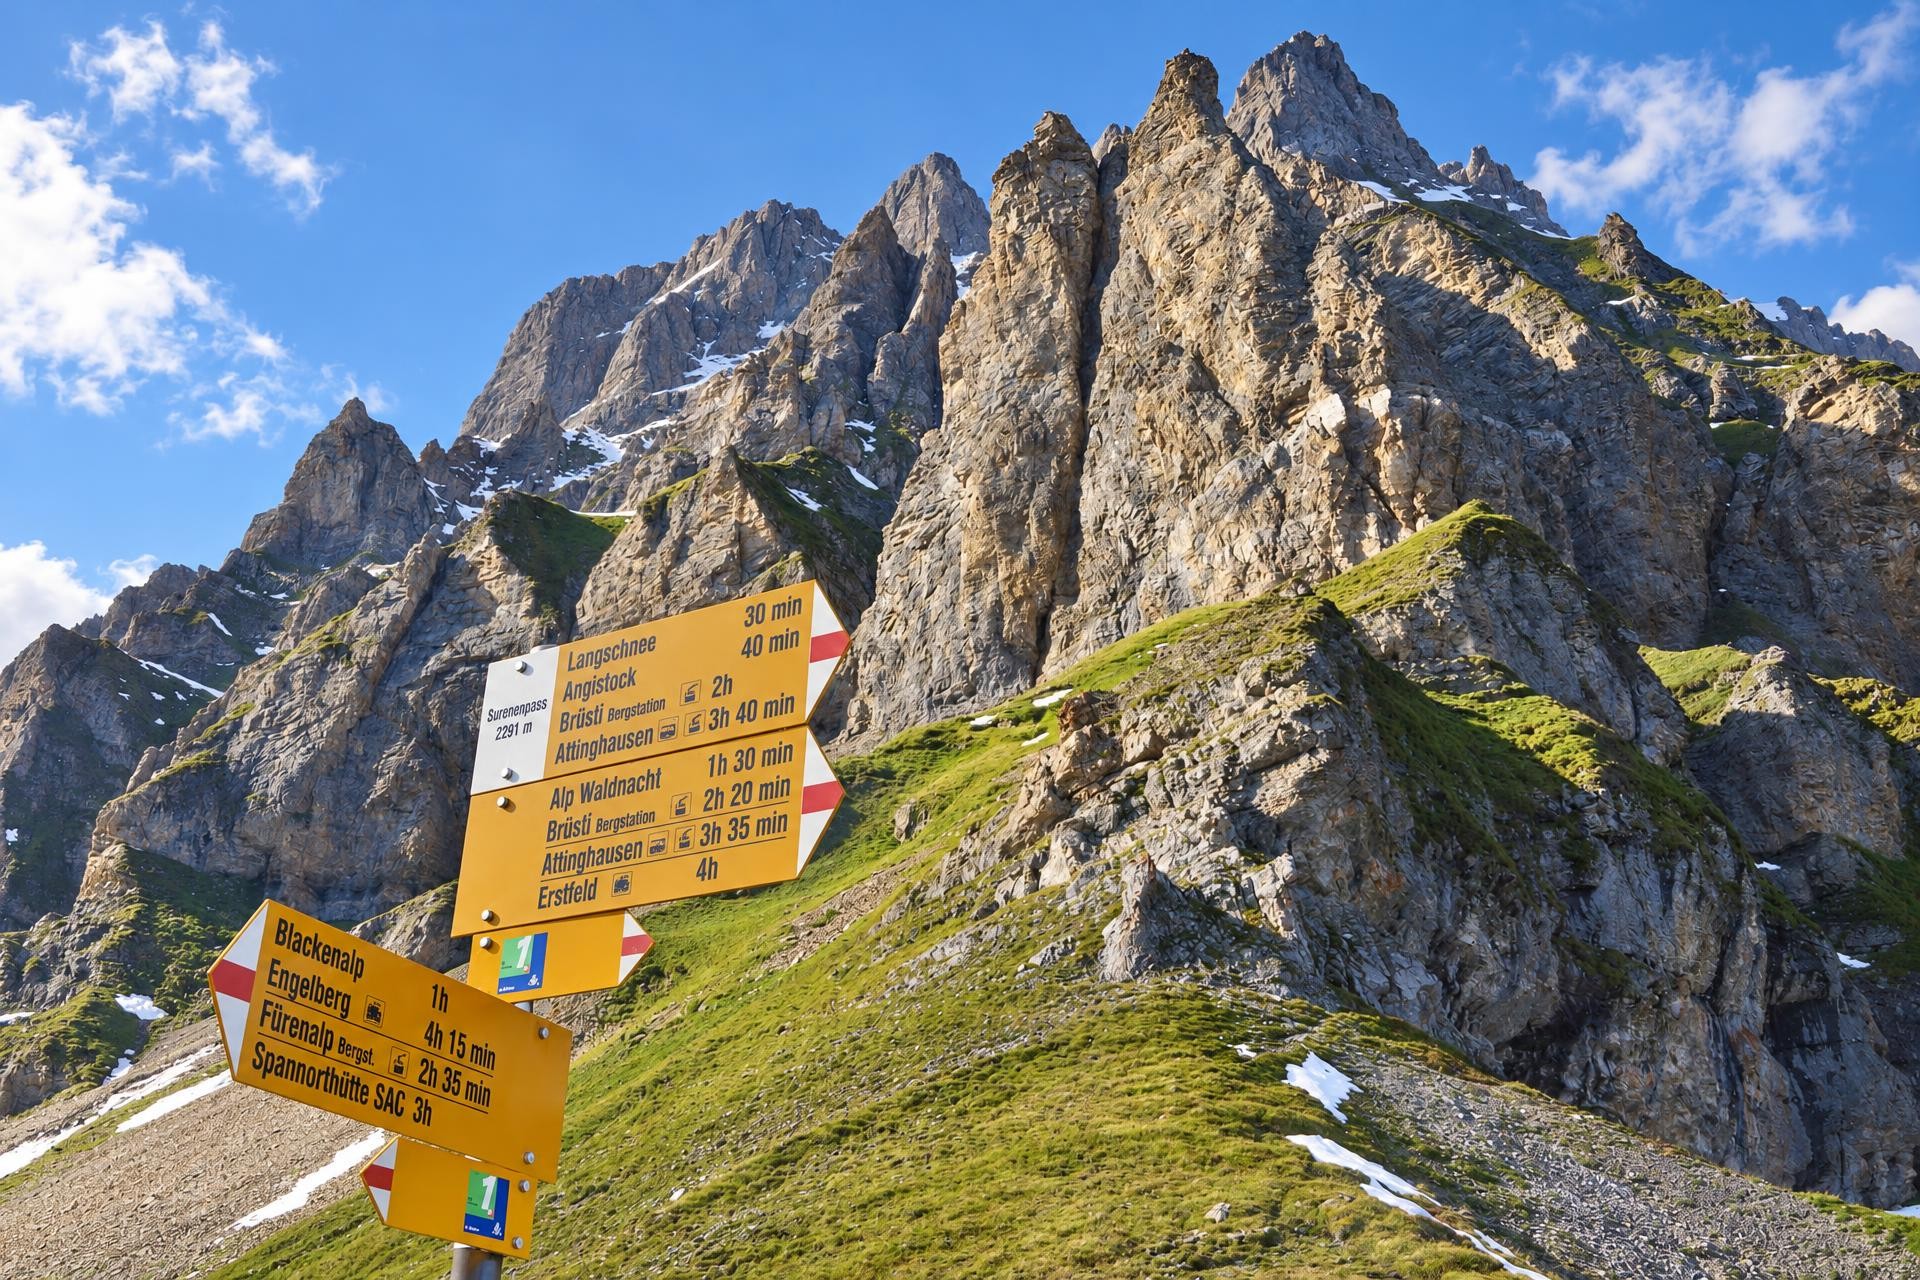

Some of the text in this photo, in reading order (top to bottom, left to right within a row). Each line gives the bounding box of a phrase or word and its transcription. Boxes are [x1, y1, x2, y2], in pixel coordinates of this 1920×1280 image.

[562, 629, 800, 703] Angistock 40 min
[568, 596, 802, 672] Langschnee 30 min
[488, 699, 547, 722] Surenenpass
[495, 722, 532, 740] 2291 m
[555, 693, 795, 764] Attinghausen 3h 40 min
[559, 674, 732, 733] Brüsti Bergstation 2h
[546, 776, 790, 842] Brüsti Bergstation 2h 20 min
[550, 741, 793, 810] Alp Waldnacht 1h 30 min
[542, 812, 788, 876] Attinghausen 3h 35 min
[538, 857, 717, 910] Erstfeld 4h
[275, 918, 448, 1013] Blackenalp 1h
[517, 935, 531, 968] 1
[267, 959, 496, 1070] Engelberg 4h 15 min
[252, 1042, 432, 1126] Spannorthütte SAC 3h
[259, 999, 490, 1107] Fürenalp Bergst. 2h 35 min
[483, 1176, 496, 1210] 1
